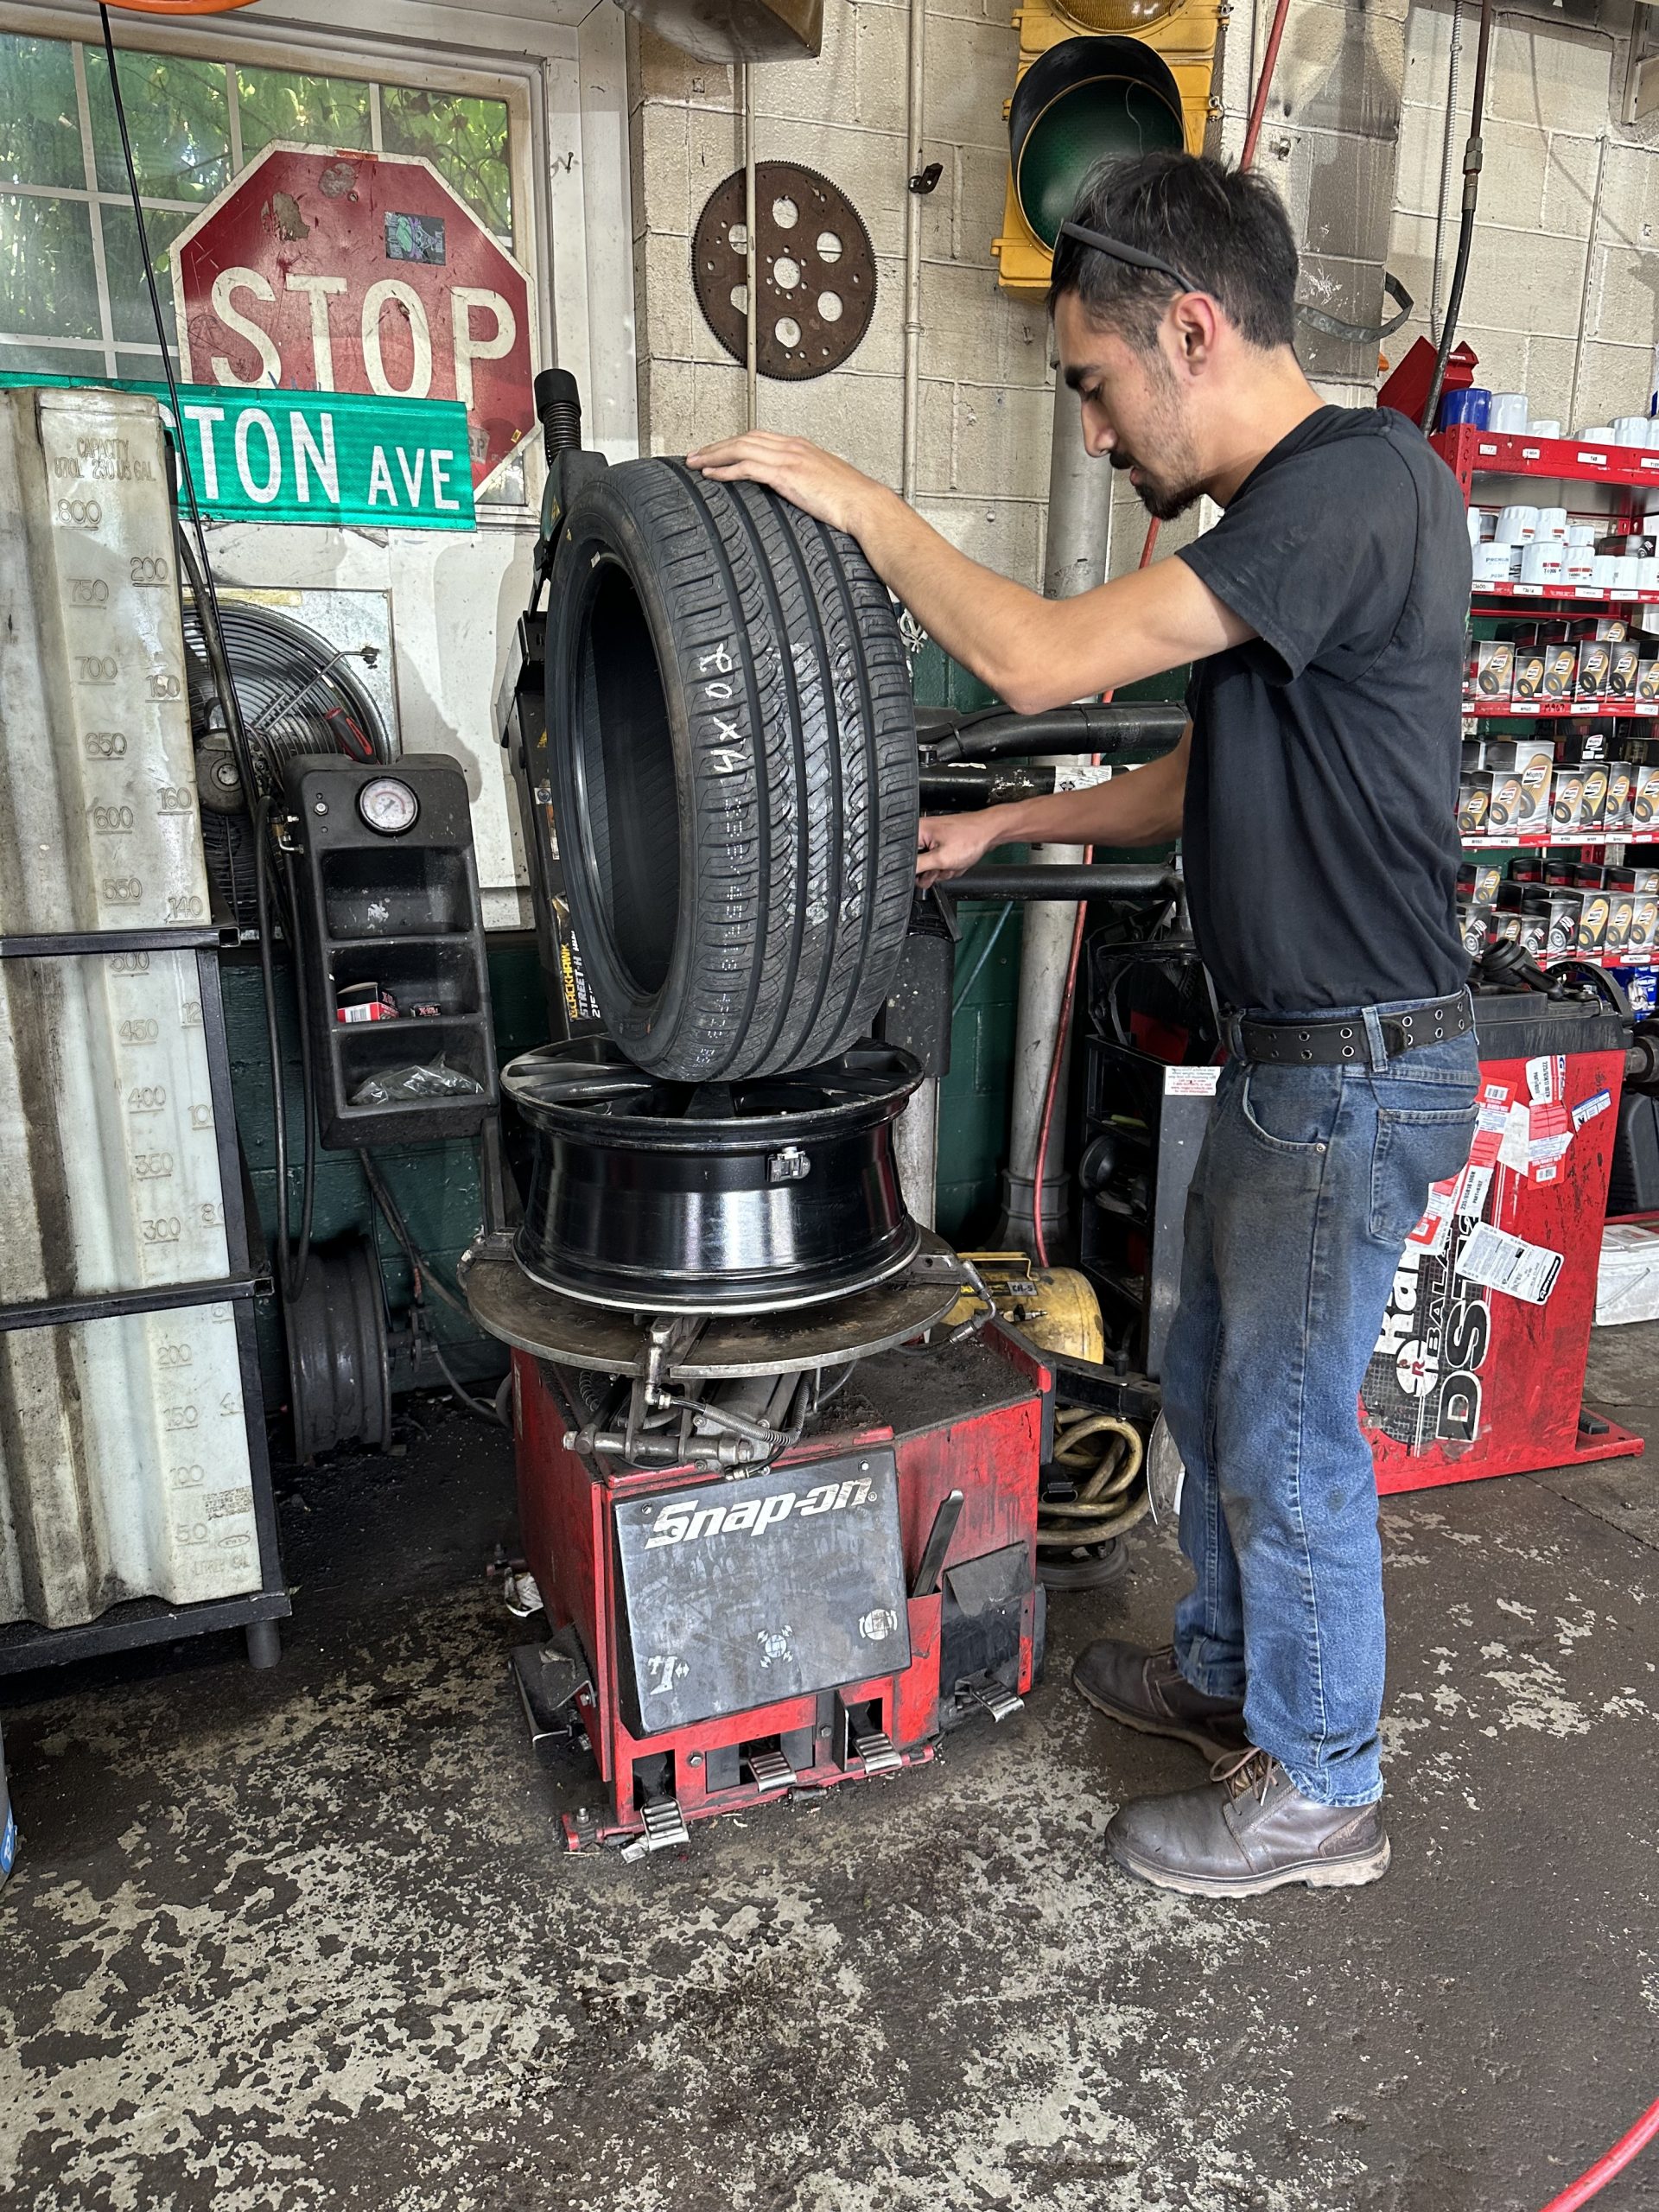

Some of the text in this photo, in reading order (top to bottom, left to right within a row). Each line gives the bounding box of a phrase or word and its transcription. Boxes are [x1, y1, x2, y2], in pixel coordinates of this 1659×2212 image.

[211, 267, 516, 409] STOP
[77, 437, 129, 460] CAPACITY
[159, 405, 460, 510] TON AVE
[58, 499, 102, 524] 800
[130, 556, 168, 582] 200
[67, 579, 109, 601] 750
[75, 657, 118, 679] 700
[146, 674, 180, 697] 180
[86, 733, 127, 756] 650
[157, 787, 191, 810] 160
[94, 806, 133, 829] 600
[103, 878, 143, 899] 550
[168, 896, 203, 918] 140
[111, 951, 149, 971] 500
[573, 957, 588, 1017] STREET-H
[182, 1002, 203, 1022] 12
[119, 1019, 158, 1040] 450
[129, 1085, 166, 1108] 400
[135, 1153, 173, 1175] 350
[143, 1217, 181, 1240] 300
[158, 1344, 192, 1364] 200
[164, 1405, 198, 1427] 150
[170, 1465, 204, 1485] 100
[645, 1478, 873, 1549] Snap-on
[175, 1523, 207, 1541] 50
